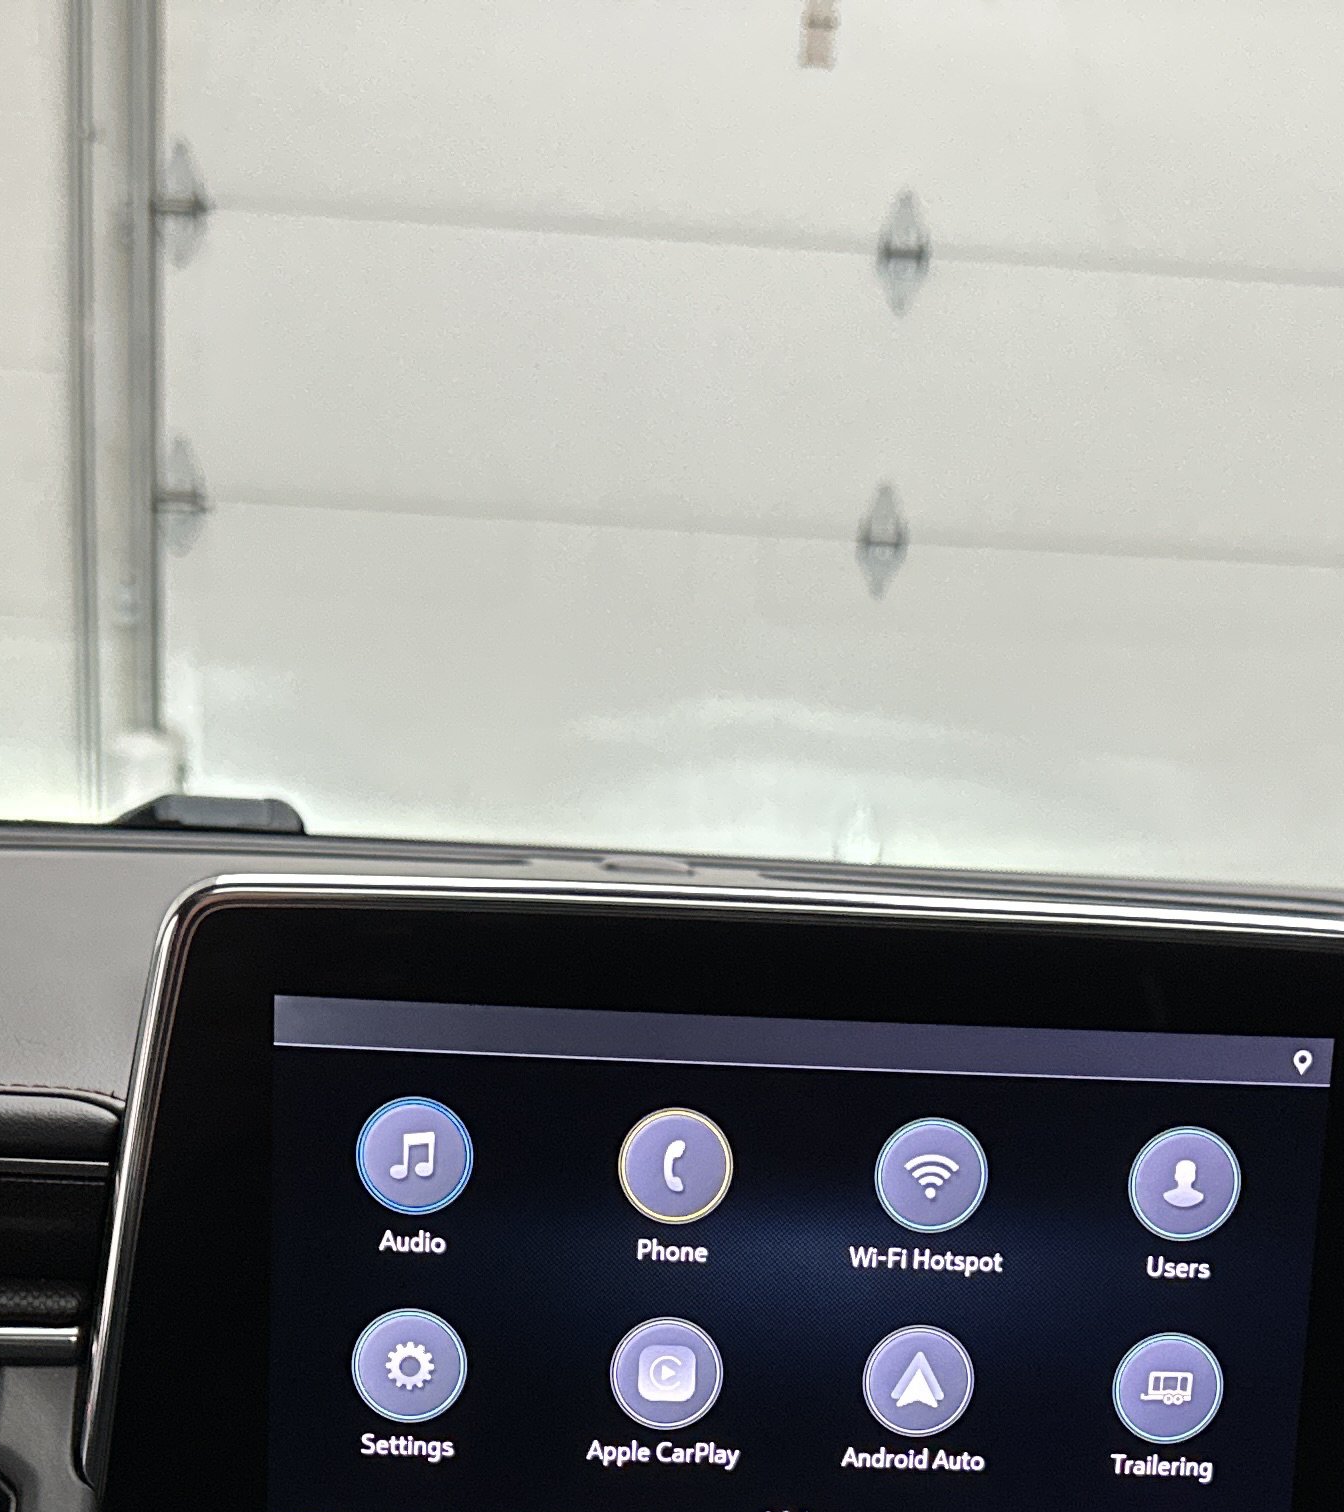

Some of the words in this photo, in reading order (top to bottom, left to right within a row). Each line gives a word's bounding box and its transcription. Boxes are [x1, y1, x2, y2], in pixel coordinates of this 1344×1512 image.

[379, 1230, 446, 1254] Audio
[637, 1238, 708, 1262] Phone
[849, 1246, 907, 1269] Wi-Fi
[913, 1248, 1003, 1277] Hotspot
[1147, 1256, 1210, 1279] Users
[361, 1433, 454, 1463] Settings
[586, 1440, 651, 1467] Apple
[656, 1442, 740, 1470] CarPlay
[841, 1447, 928, 1469] Android
[932, 1450, 985, 1471] Auto
[1111, 1454, 1212, 1484] Trailering
